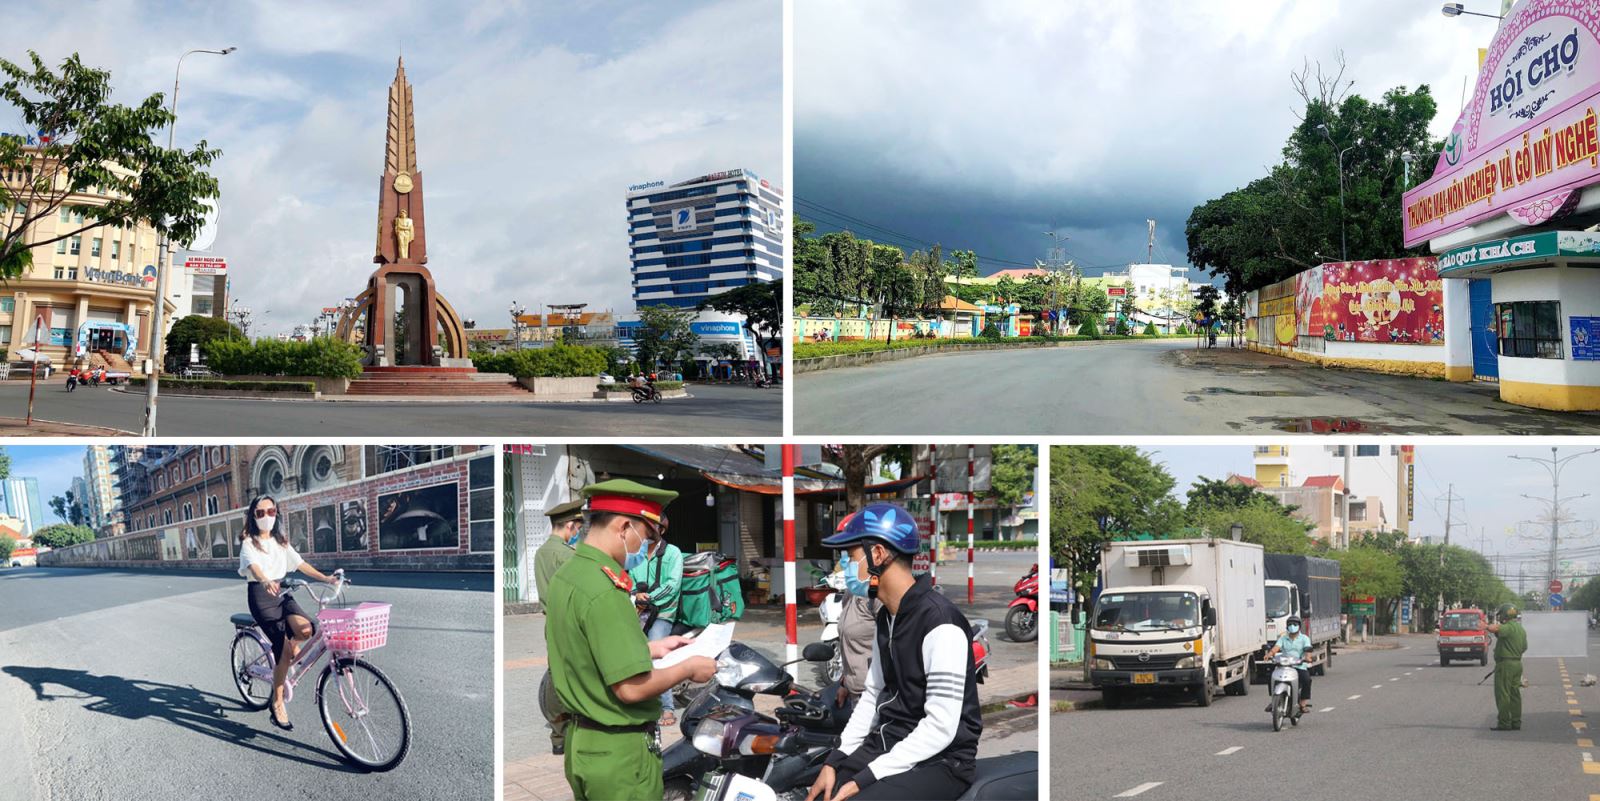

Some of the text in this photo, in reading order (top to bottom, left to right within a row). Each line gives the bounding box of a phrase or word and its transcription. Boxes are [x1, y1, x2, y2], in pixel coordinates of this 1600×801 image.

[1490, 27, 1579, 113] HỘI CHỢ
[1499, 149, 1514, 191] VÀ
[1533, 127, 1553, 178] MỸ
[1555, 106, 1599, 168] NGHỆ
[628, 179, 665, 191] vinaphone
[1456, 246, 1477, 266] QUÝ
[1479, 240, 1536, 260] KHÁCH
